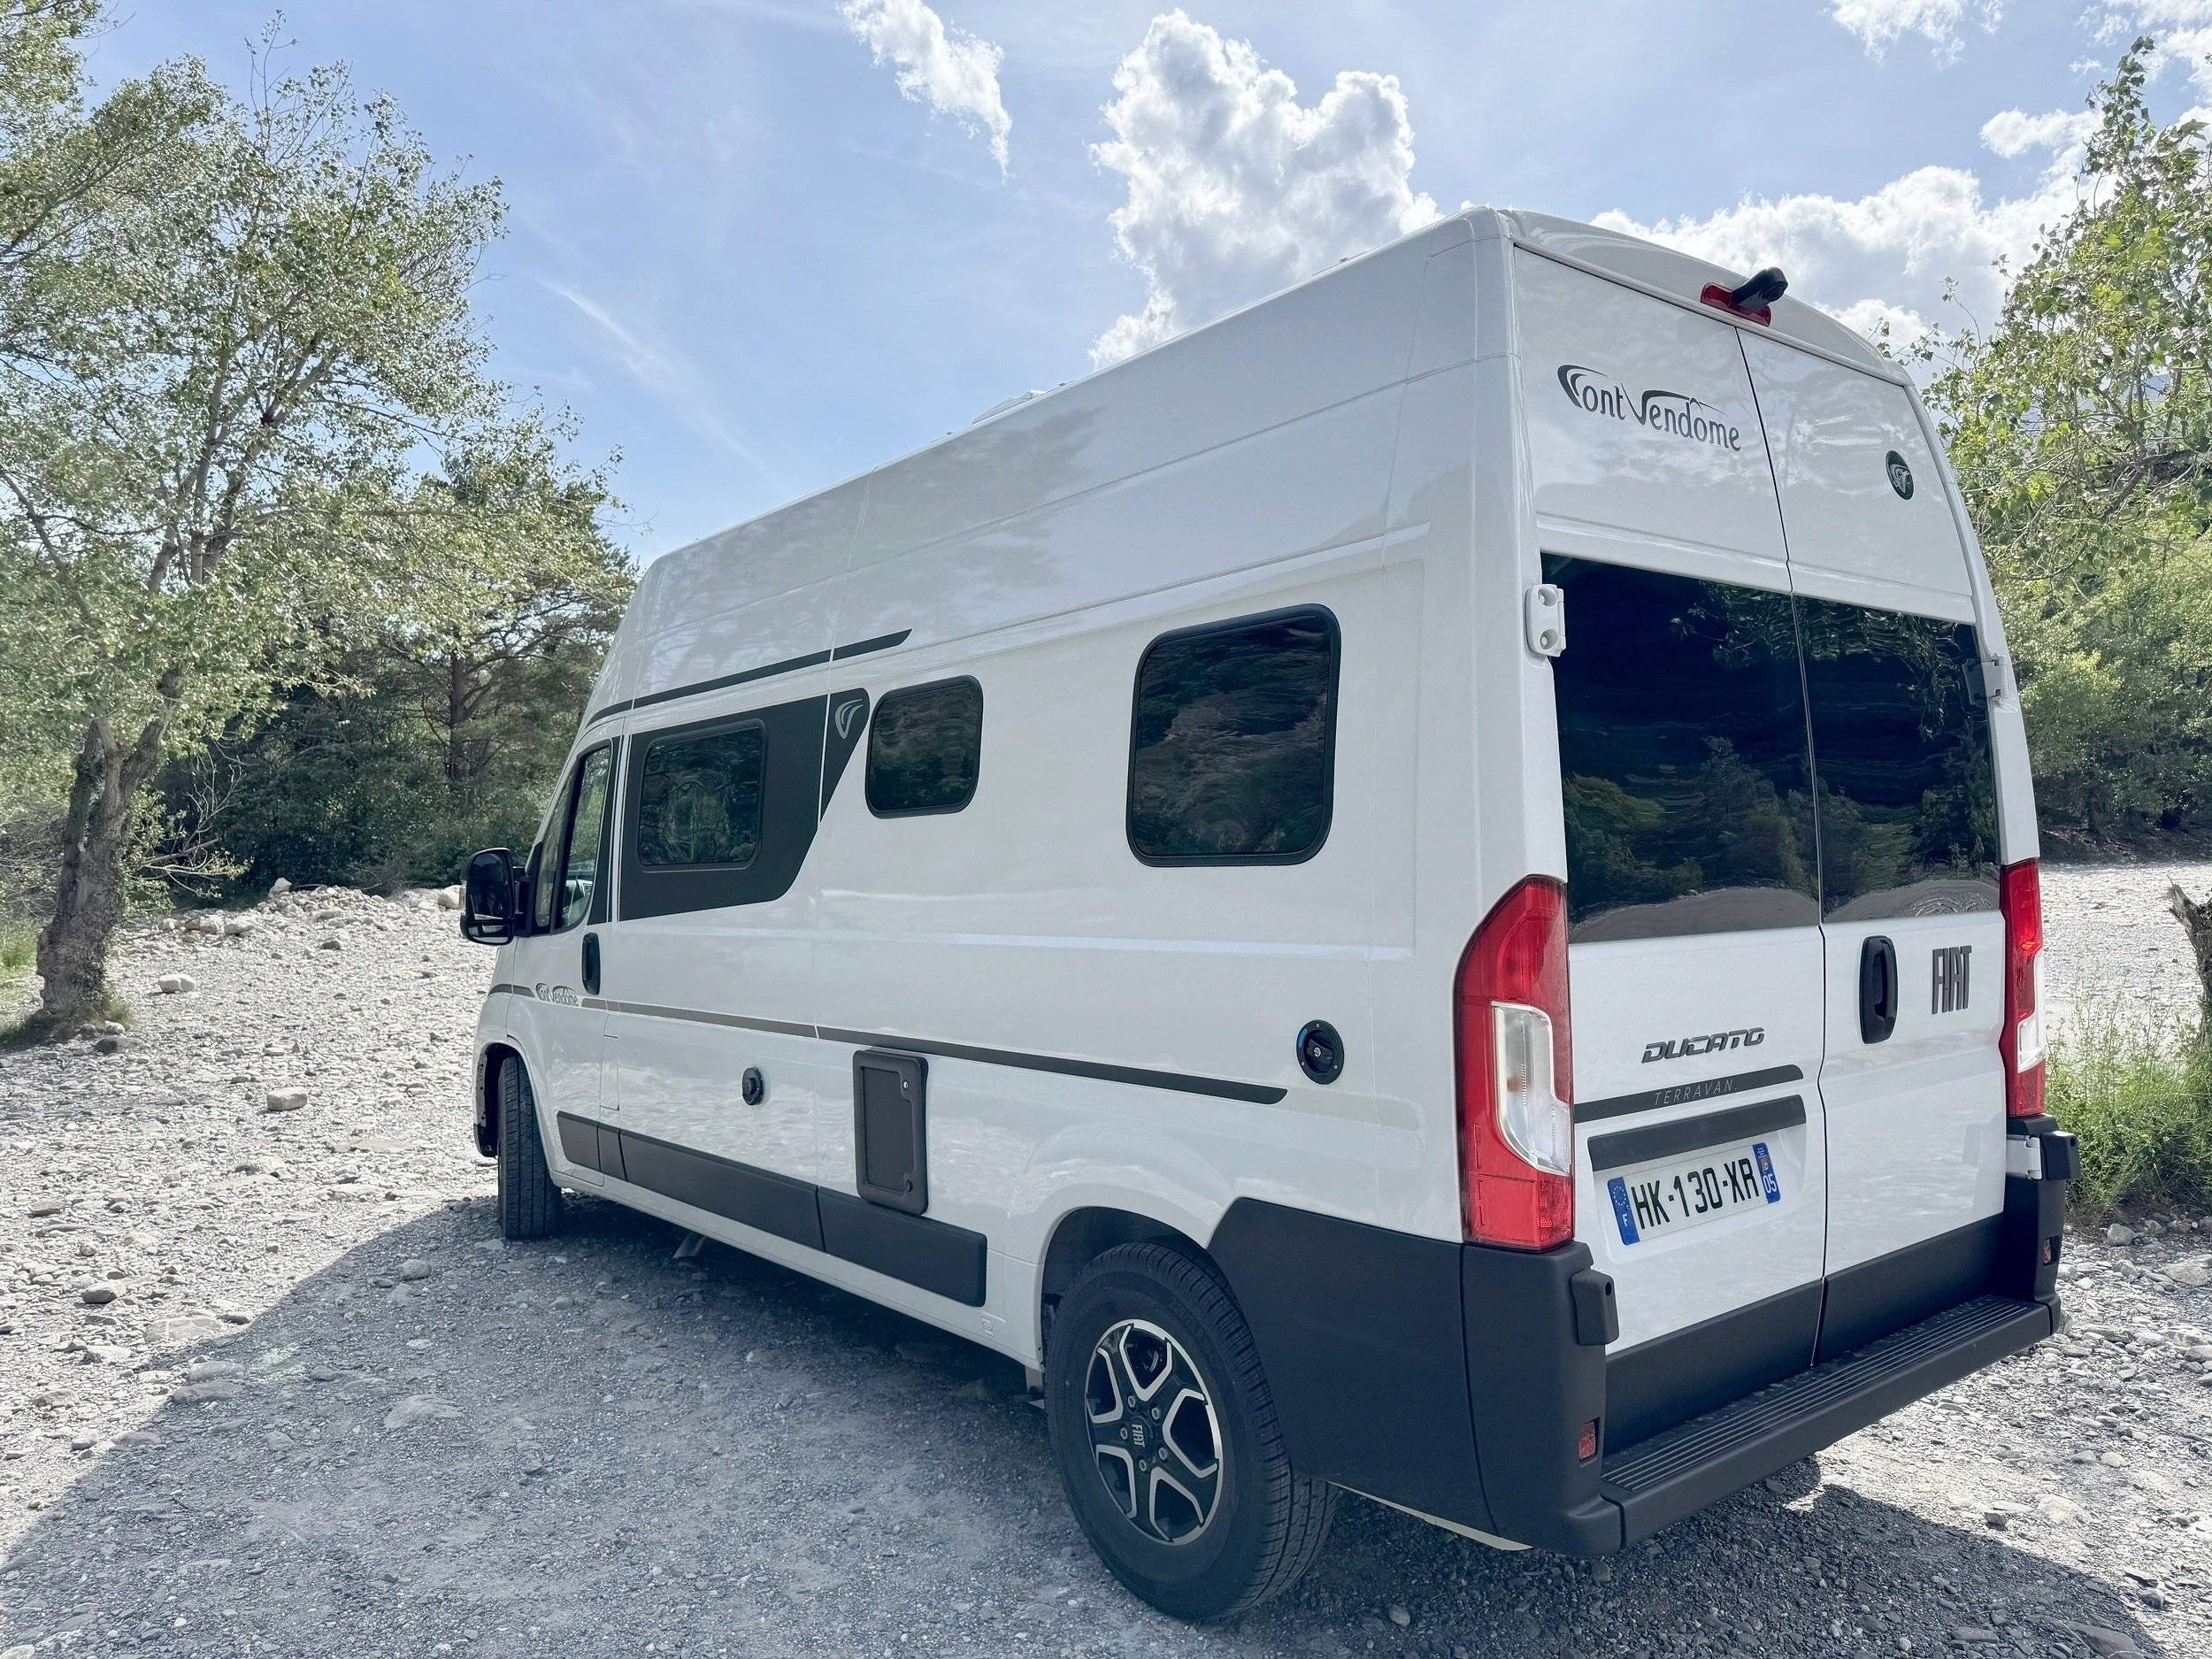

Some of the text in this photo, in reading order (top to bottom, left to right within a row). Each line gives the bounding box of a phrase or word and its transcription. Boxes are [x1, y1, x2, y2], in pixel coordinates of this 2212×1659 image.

[1932, 945, 1972, 1015] FIAT
[1641, 1026, 1764, 1064] DUCATO
[1631, 1157, 1759, 1229] HK-130-XR
[1763, 1172, 1778, 1194] 05
[1132, 1424, 1146, 1448] FIAT
